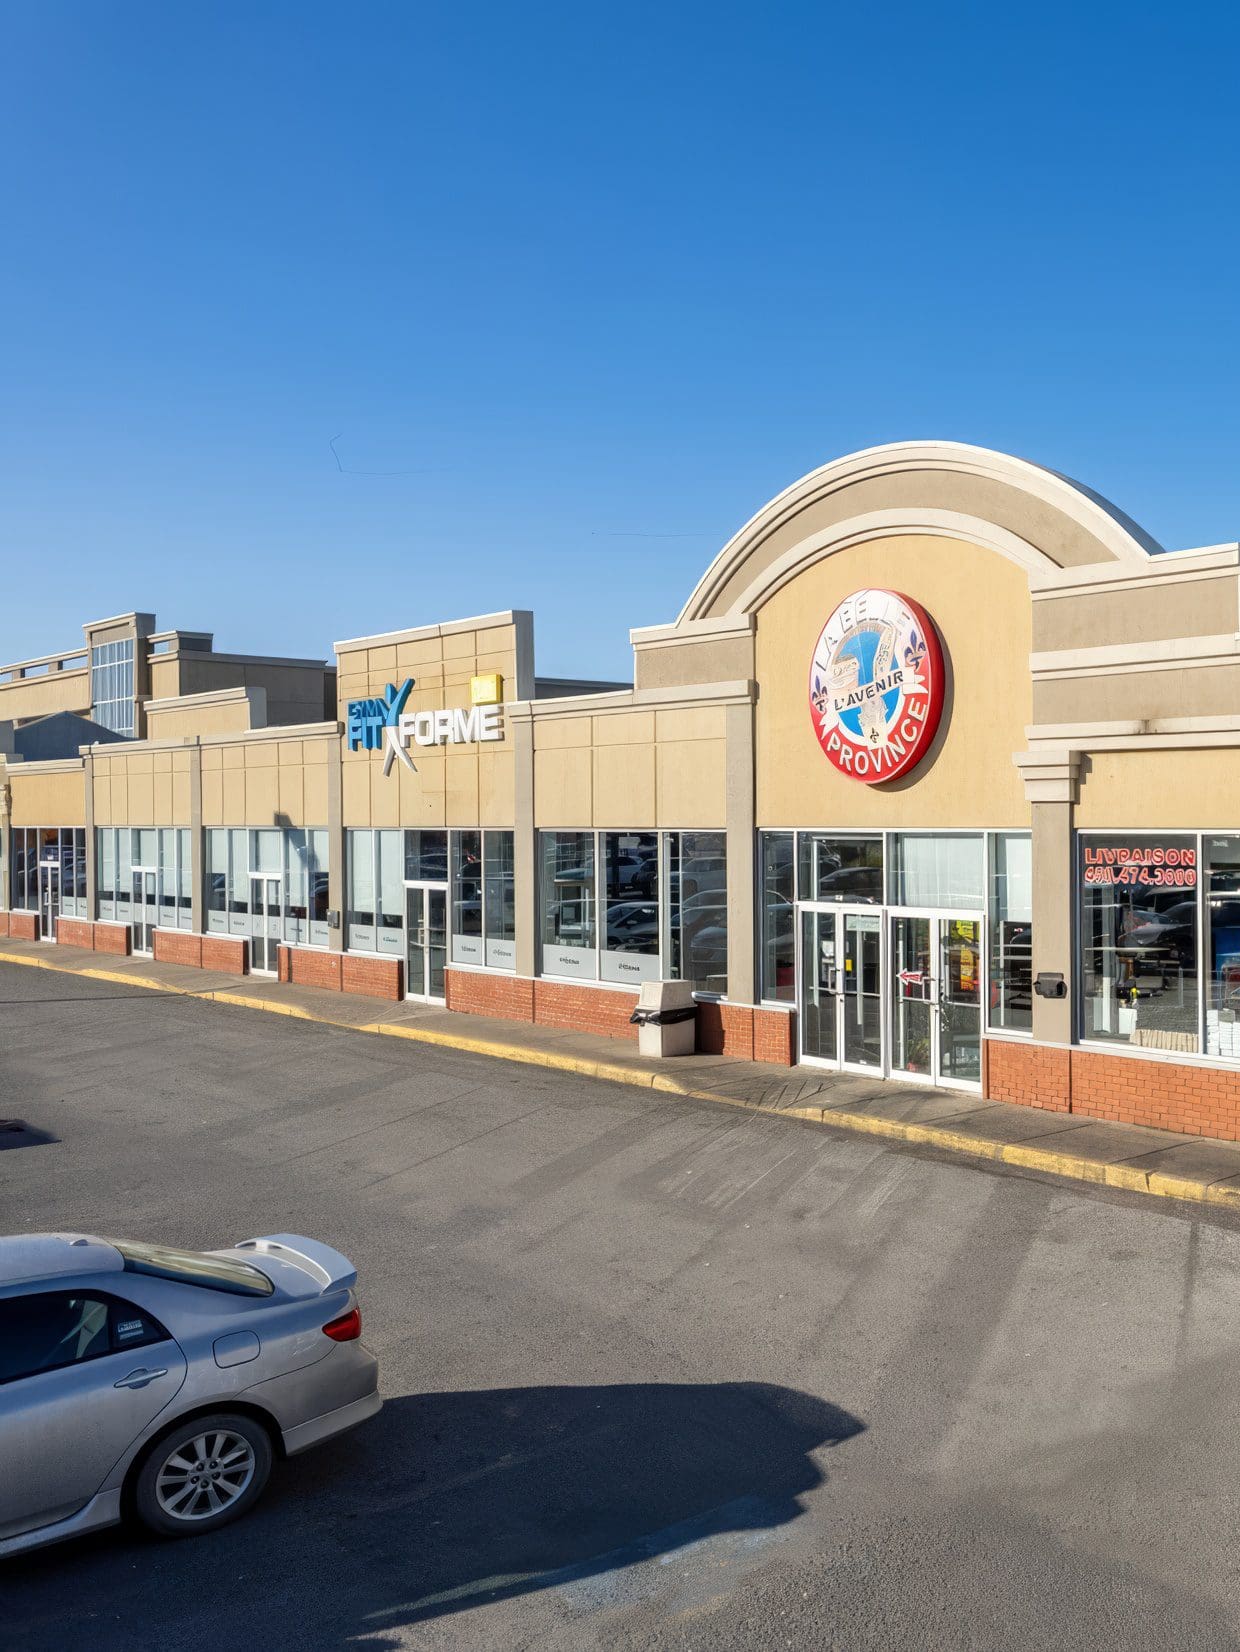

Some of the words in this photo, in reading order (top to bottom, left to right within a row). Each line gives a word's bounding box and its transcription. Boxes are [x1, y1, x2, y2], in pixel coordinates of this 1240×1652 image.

[834, 671, 904, 712] L'AVENIR
[347, 715, 383, 751] FIT
[399, 704, 505, 748] FORME
[827, 698, 928, 775] PROVINCE
